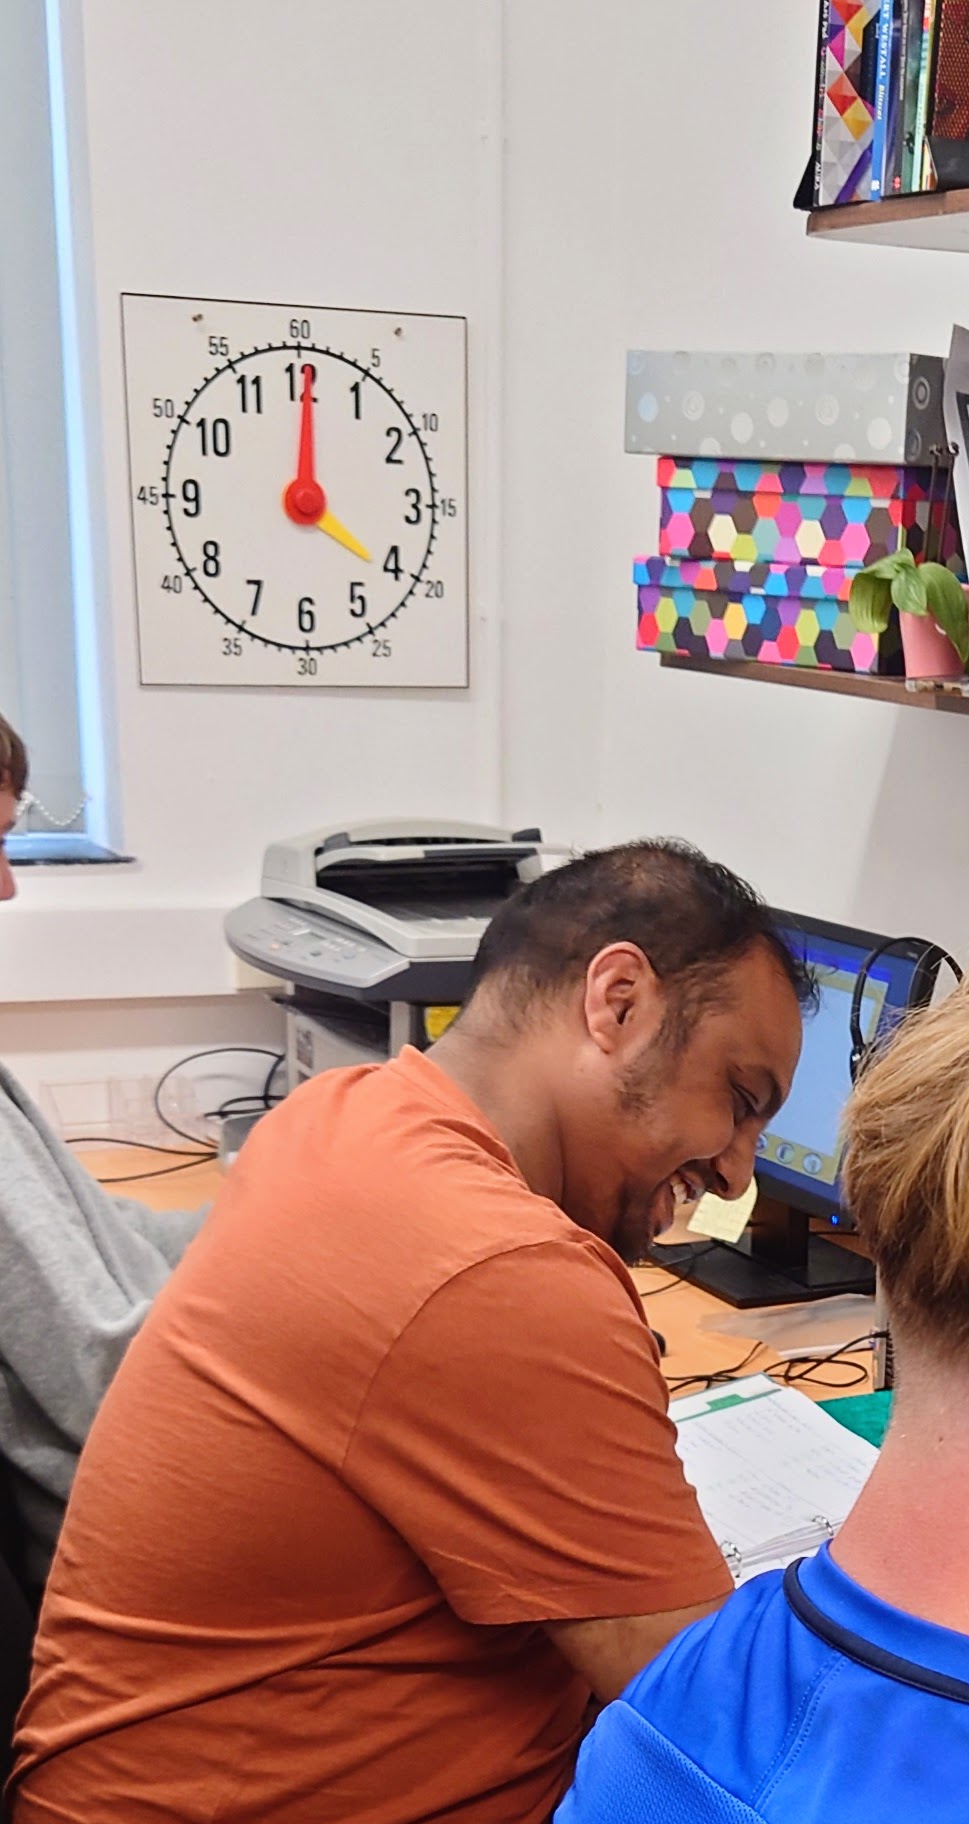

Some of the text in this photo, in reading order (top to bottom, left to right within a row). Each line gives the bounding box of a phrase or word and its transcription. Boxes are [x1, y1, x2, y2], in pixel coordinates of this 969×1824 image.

[879, 23, 892, 79] WESTALL
[290, 320, 310, 338] 60
[208, 336, 229, 357] 55
[371, 349, 381, 367] 5
[236, 374, 263, 414] 11
[350, 381, 362, 420] 1
[153, 398, 175, 419] 50
[422, 414, 439, 432] 10
[197, 418, 231, 457] 10
[386, 427, 404, 465] 2
[137, 487, 159, 505] 45
[182, 479, 201, 517] 9
[405, 488, 422, 525] 3
[440, 499, 457, 517] 15
[203, 541, 221, 578] 8
[383, 545, 404, 581] 4
[161, 575, 183, 595] 40
[246, 579, 263, 617] 7
[425, 580, 444, 599] 20
[350, 582, 367, 619] 5
[298, 597, 316, 634] 6
[222, 638, 243, 656] 35
[373, 638, 392, 657] 25
[297, 658, 317, 676] 30
